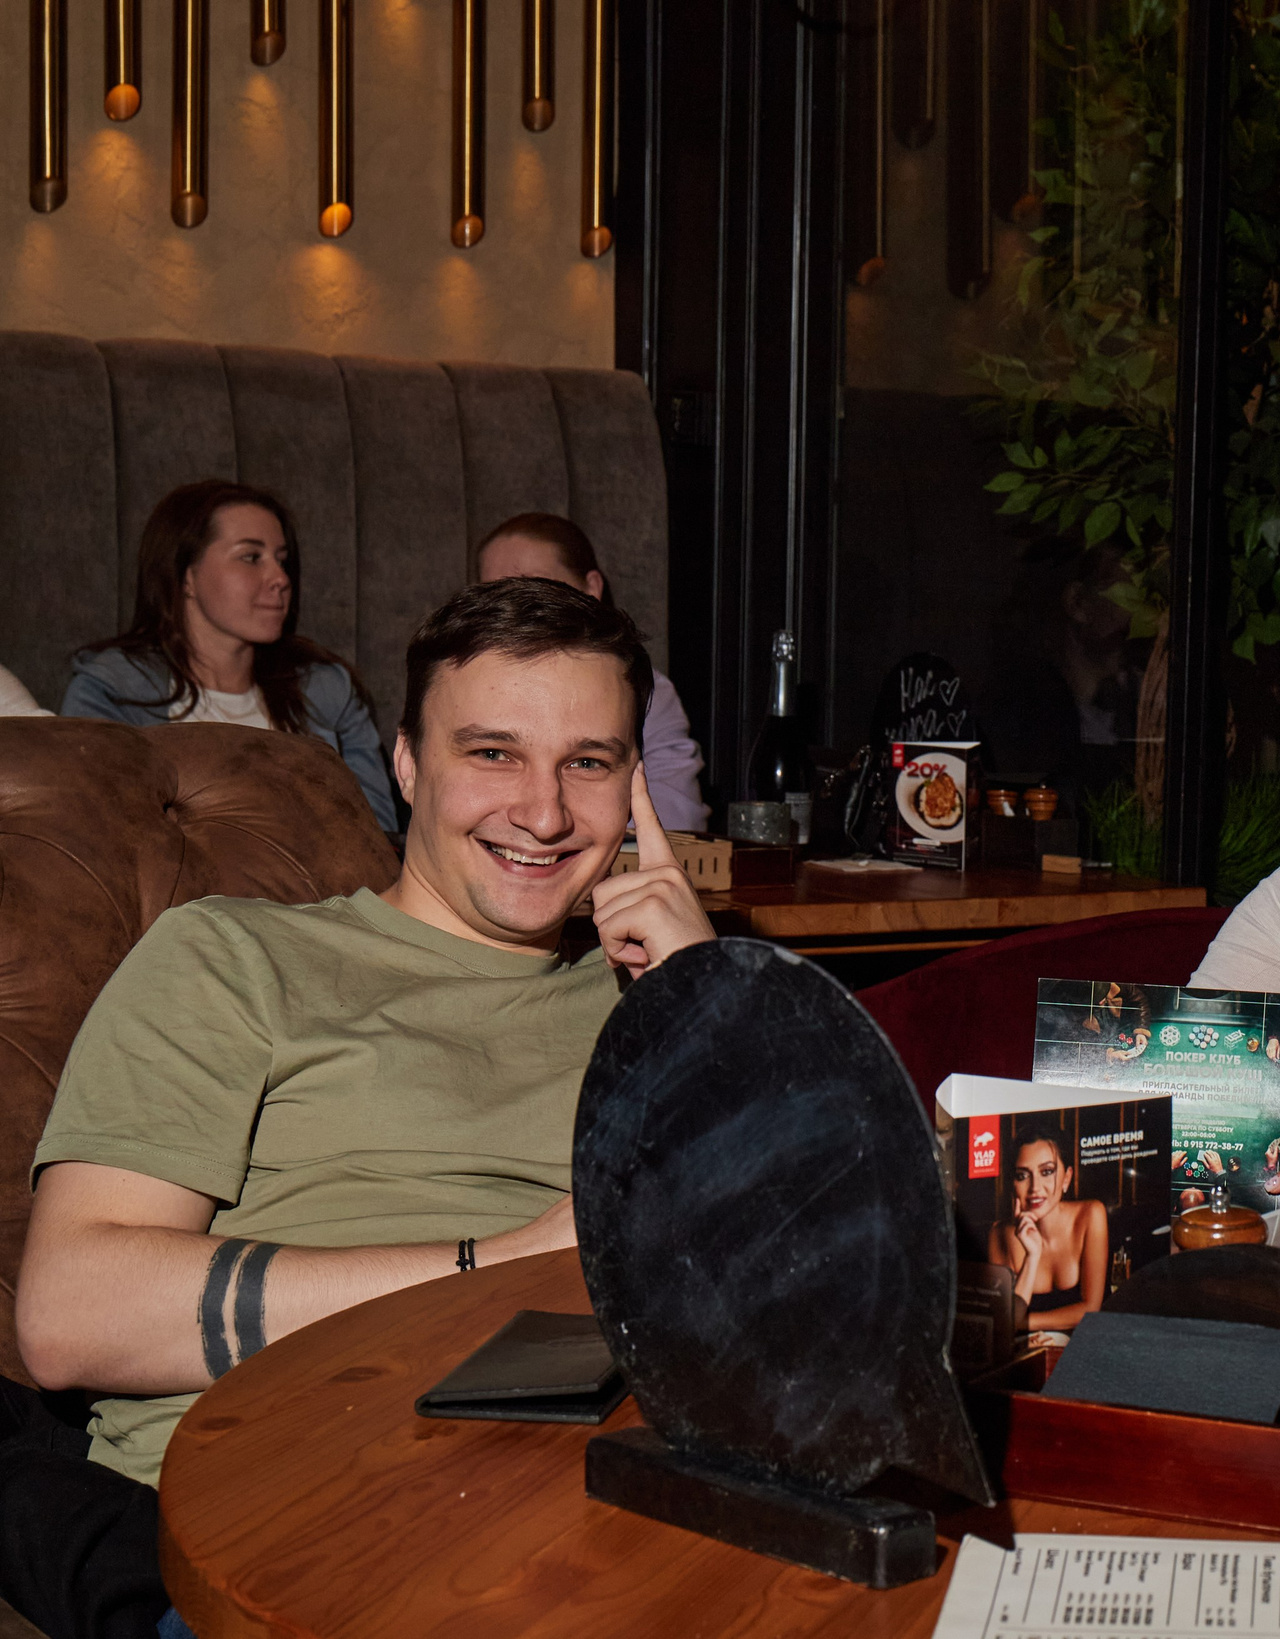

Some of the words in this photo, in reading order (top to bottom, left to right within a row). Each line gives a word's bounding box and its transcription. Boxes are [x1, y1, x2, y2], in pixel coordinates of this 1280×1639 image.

[1165, 1050, 1206, 1063] ПОКЕР
[1209, 1053, 1241, 1065] КЛУБ
[1143, 1063, 1224, 1079] БОЛЬШОЙ
[1142, 1080, 1230, 1093] ПРИГЛАСИТЕЛЬНЫЙ
[1233, 1086, 1261, 1095] БИЛЕТ
[1080, 1134, 1112, 1148] САМОЕ
[1113, 1129, 1144, 1144] ВРЕМЯ
[1183, 1140, 1189, 1148] 8
[1190, 1141, 1204, 1149] 915
[1205, 1141, 1244, 1151] 772-38-77
[974, 1150, 995, 1160] VLAD
[975, 1159, 993, 1167] BEEF
